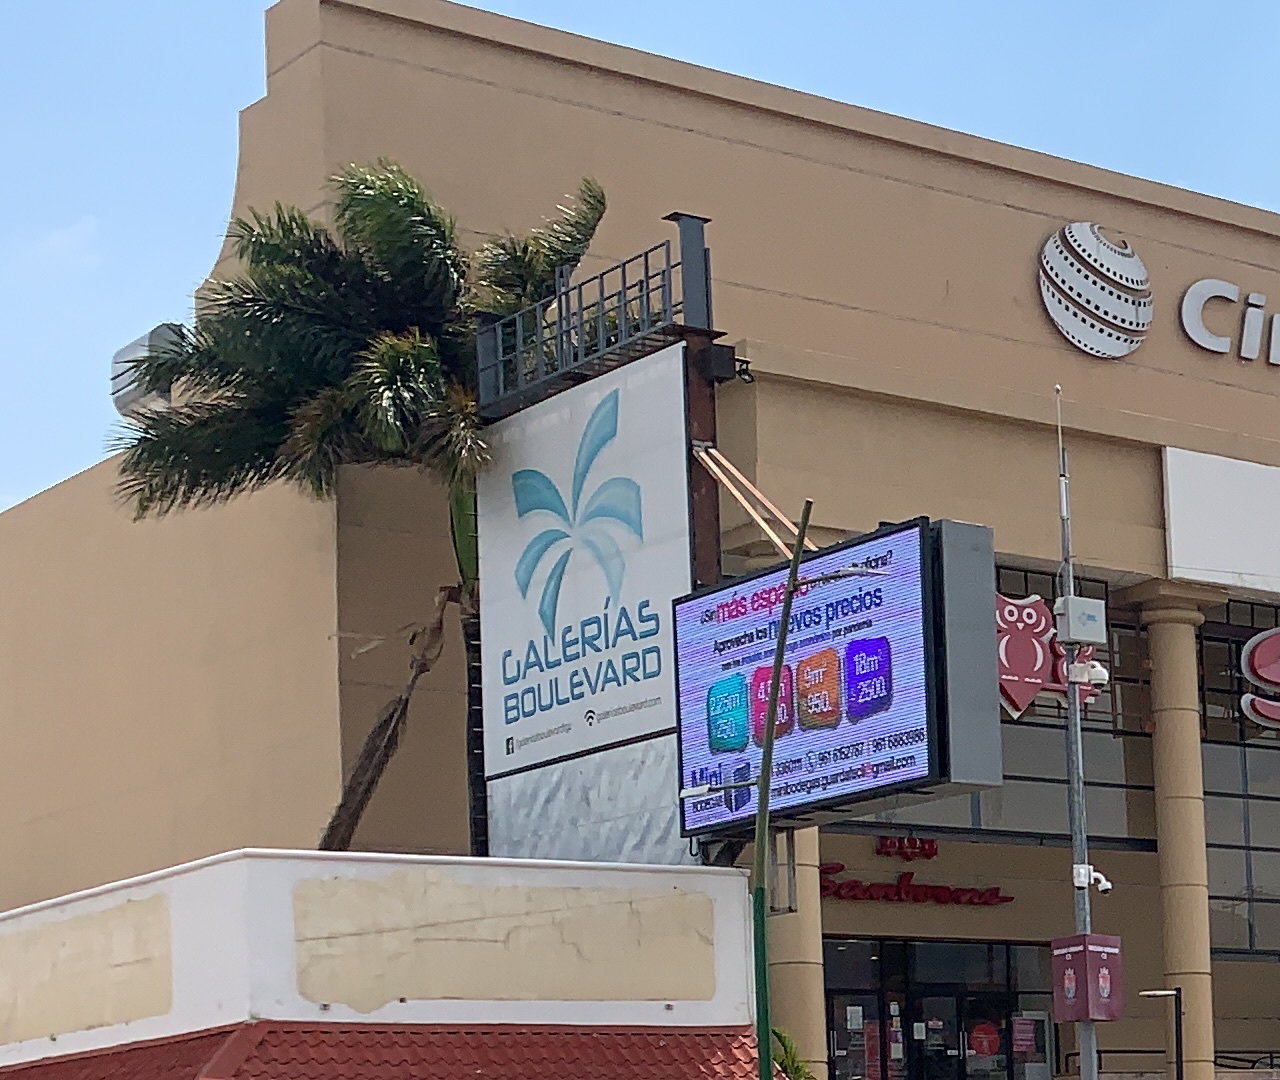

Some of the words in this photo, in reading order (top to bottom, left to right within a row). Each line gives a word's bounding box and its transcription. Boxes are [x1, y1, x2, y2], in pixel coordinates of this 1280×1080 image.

[502, 596, 660, 686] GALERÍAS
[717, 591, 748, 625] más
[768, 607, 822, 640] nevos
[825, 586, 883, 629] precios
[504, 645, 662, 725] BOULEVARD
